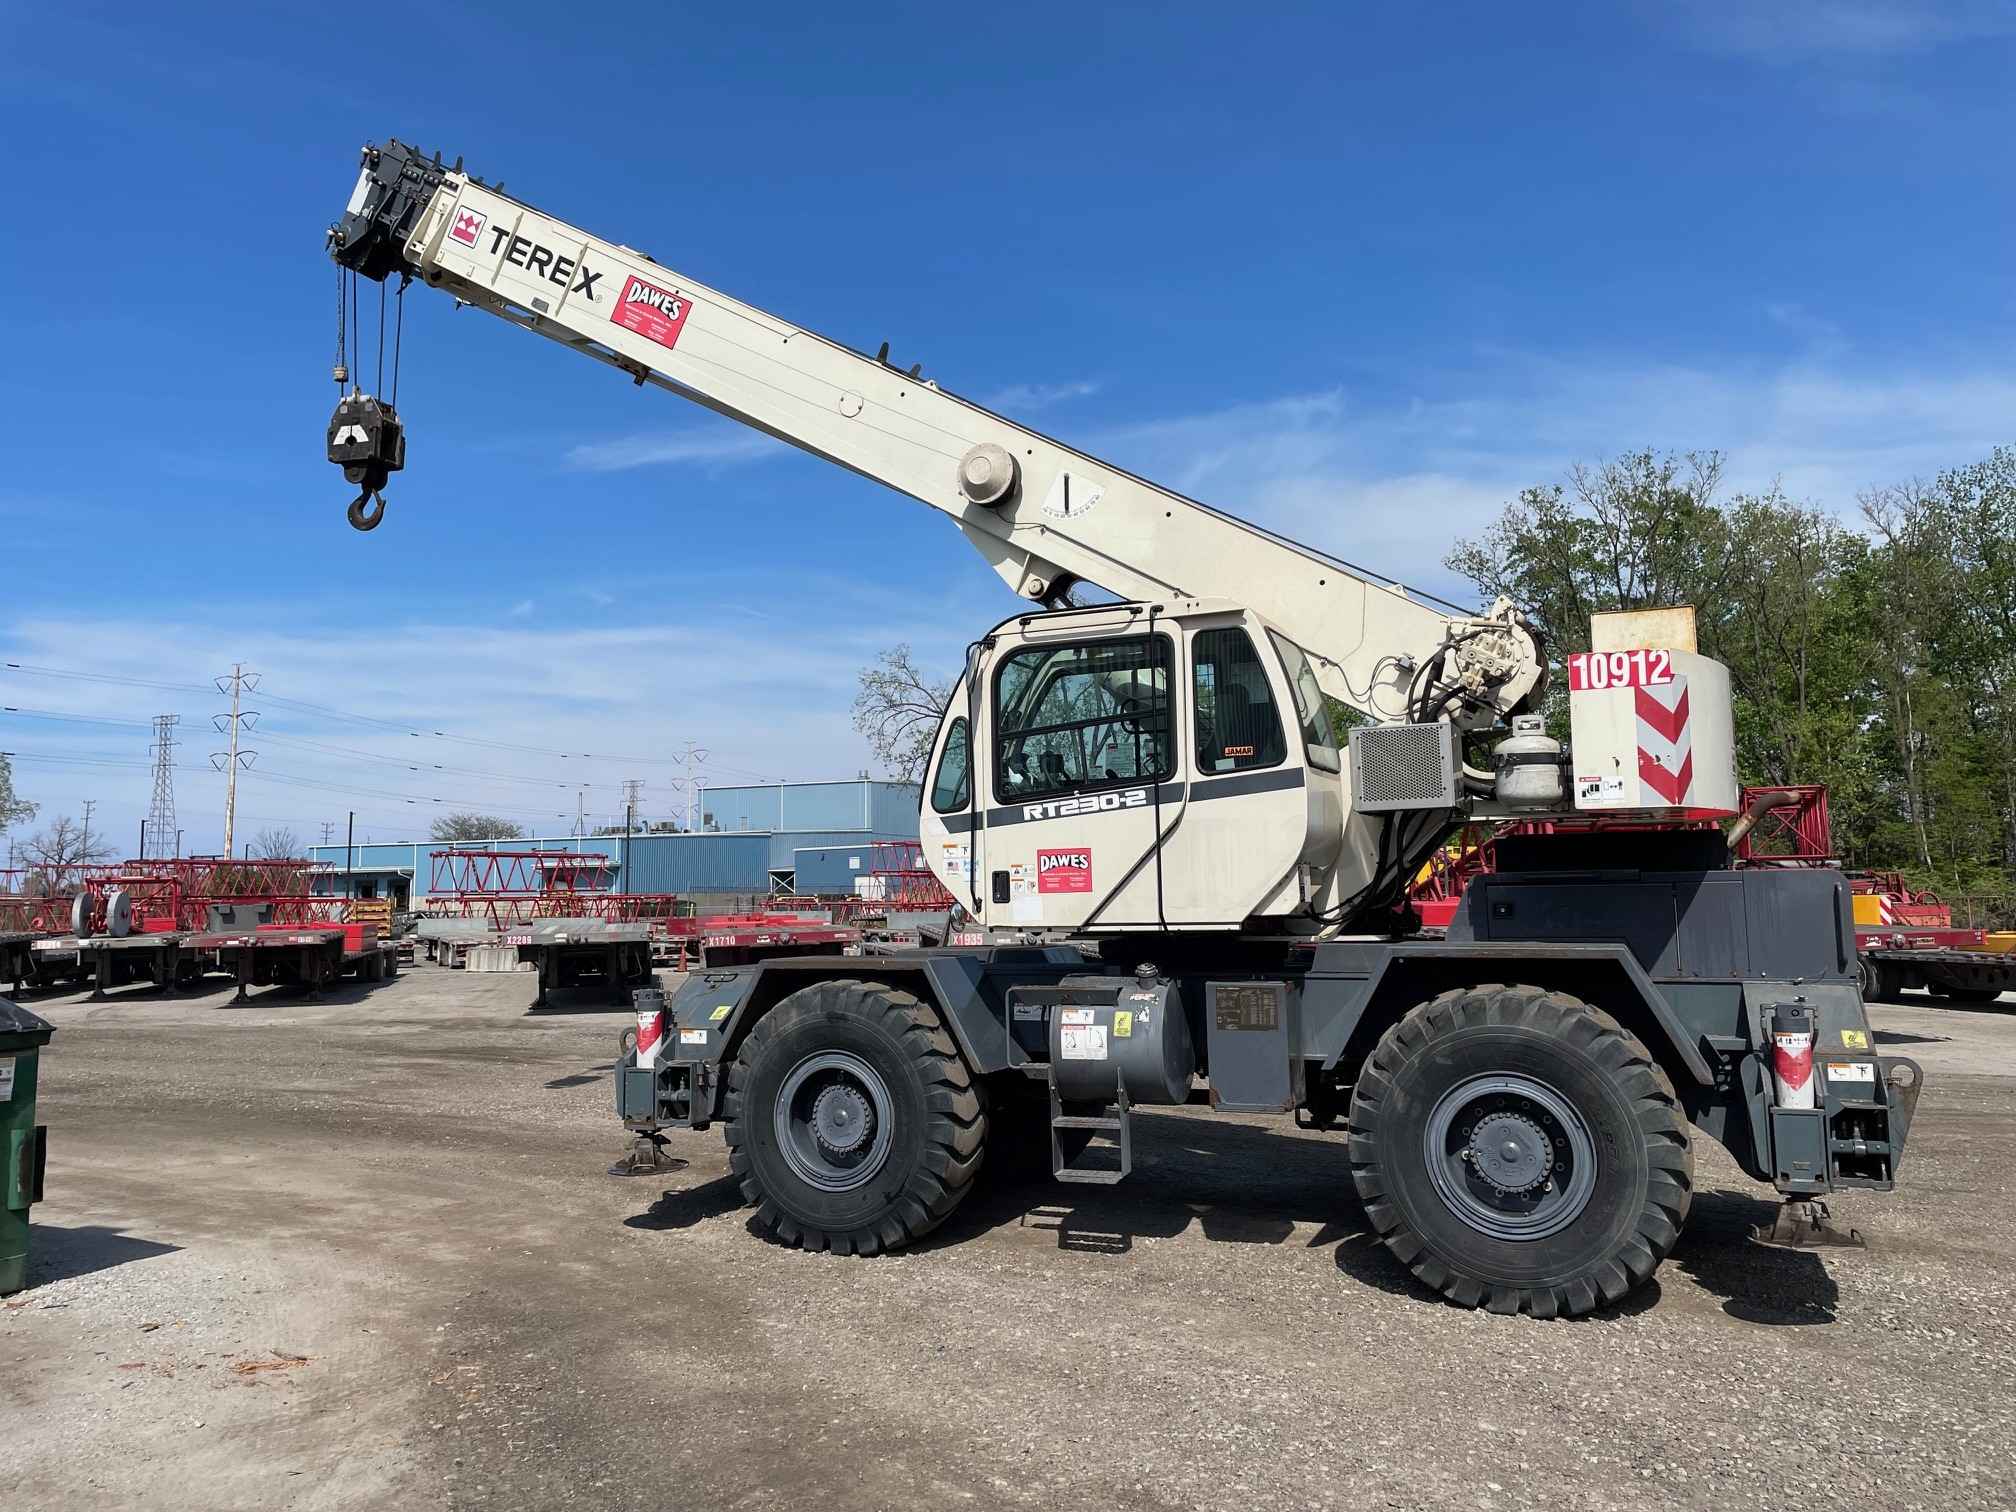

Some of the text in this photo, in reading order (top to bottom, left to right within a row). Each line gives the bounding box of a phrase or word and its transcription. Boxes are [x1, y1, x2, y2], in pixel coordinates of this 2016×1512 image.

[489, 225, 603, 301] TEREX
[625, 280, 682, 320] DAWES
[1572, 650, 1671, 688] 10912
[1022, 790, 1147, 821] RT230-2
[1040, 854, 1089, 873] DAWES
[709, 935, 736, 946] X1710
[953, 933, 982, 945] X1935
